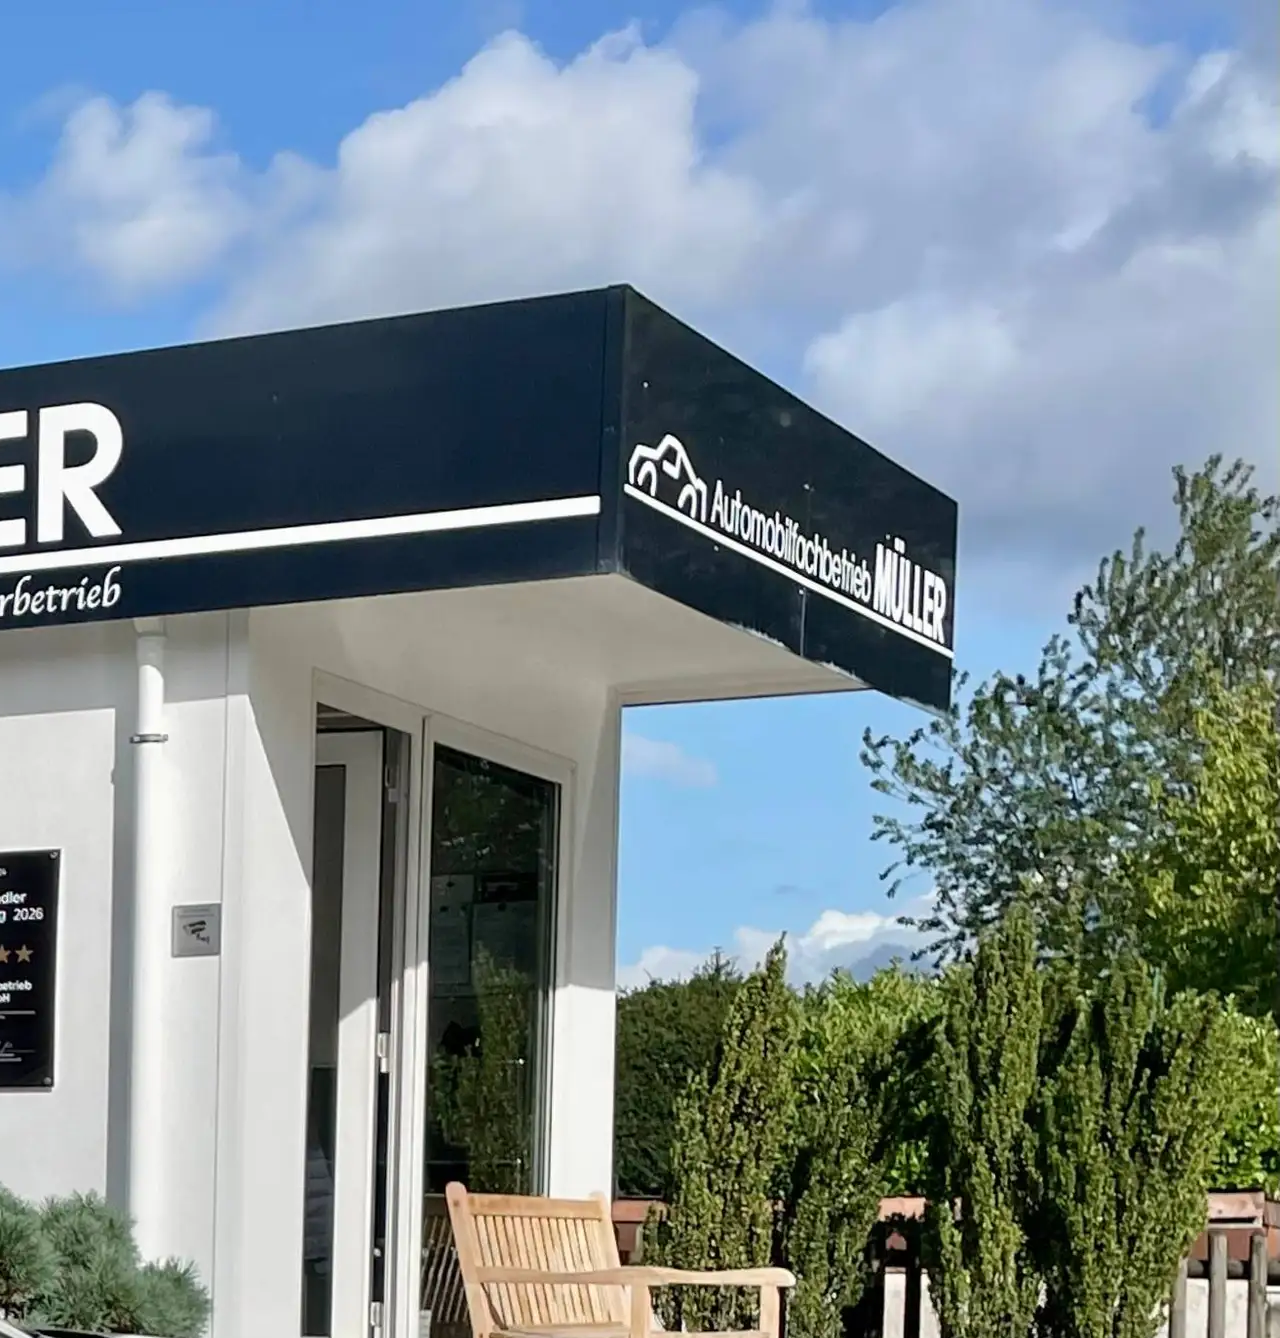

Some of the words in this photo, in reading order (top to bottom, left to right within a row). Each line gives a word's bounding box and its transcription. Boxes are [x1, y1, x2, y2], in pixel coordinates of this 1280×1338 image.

[710, 479, 872, 602] Automobilfachbetrieb
[873, 537, 947, 643] MÜLLER
[12, 907, 44, 921] 2026
